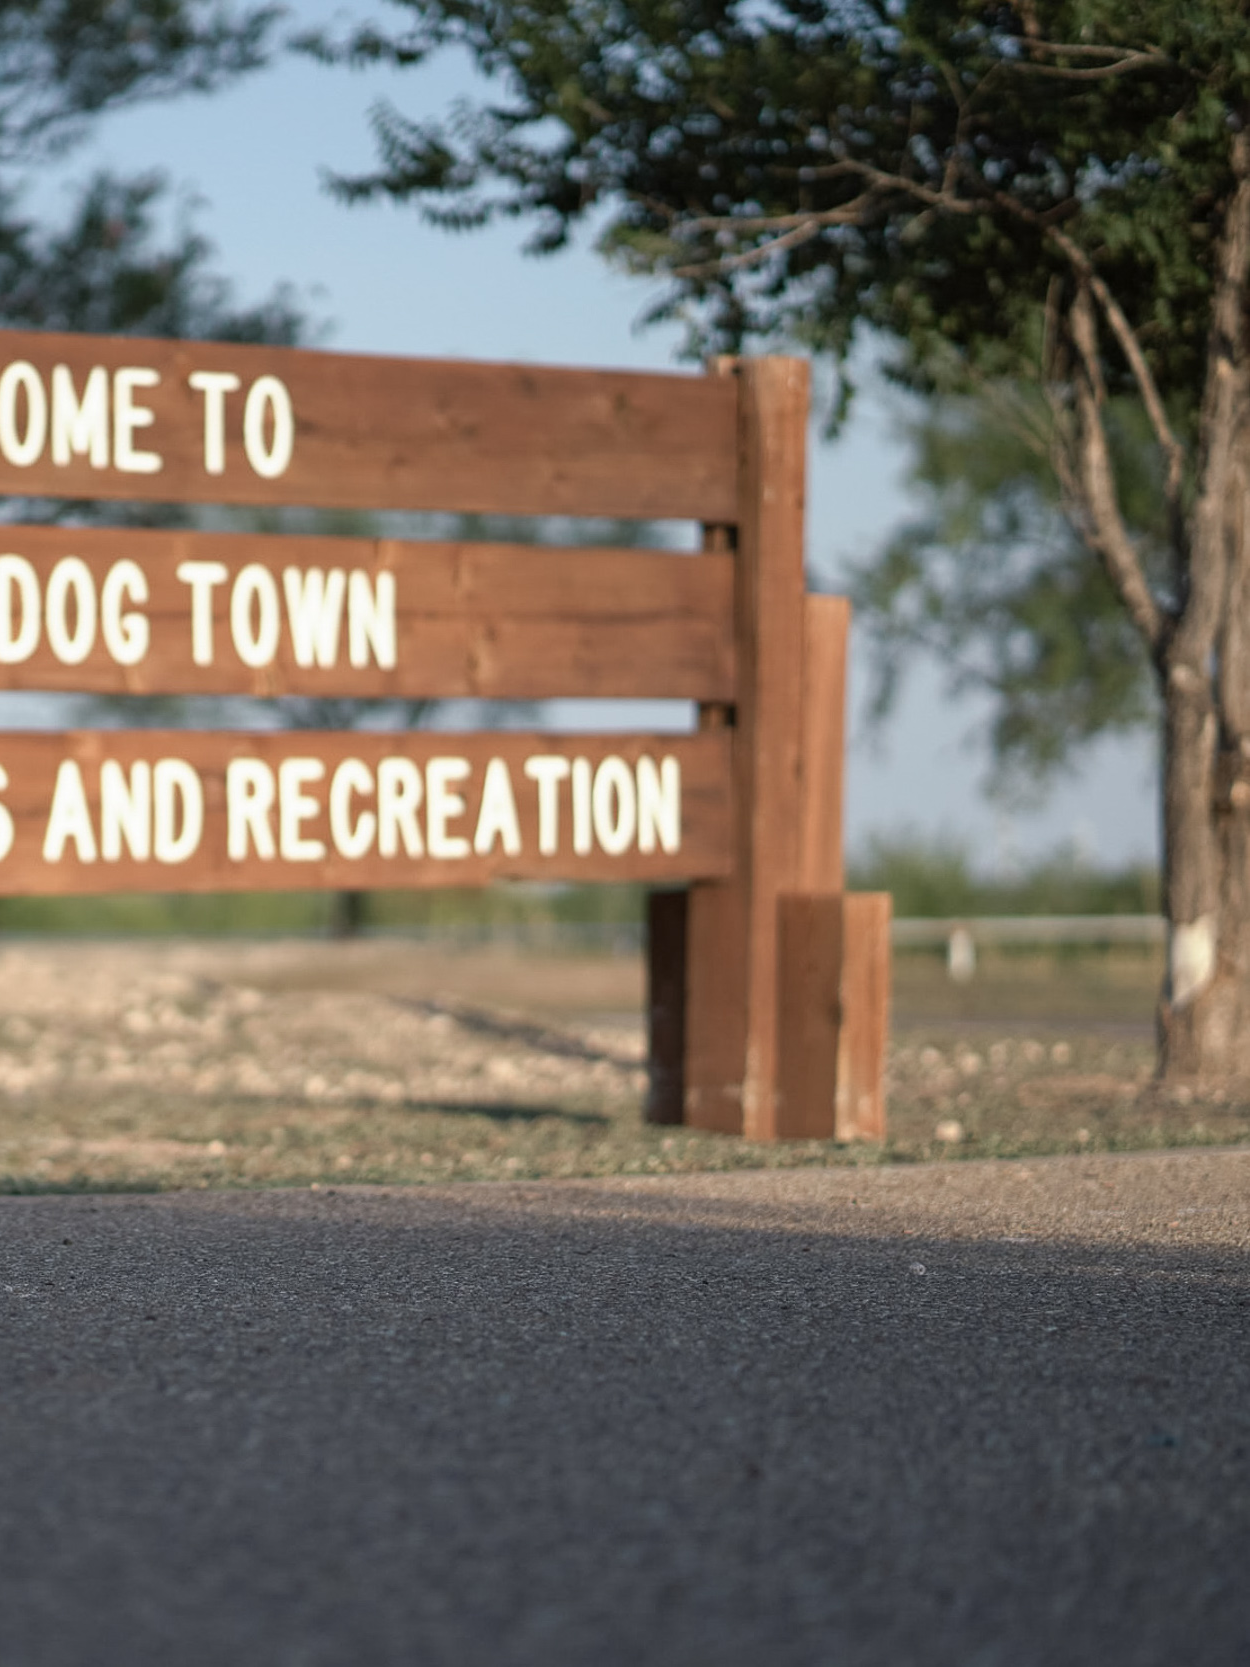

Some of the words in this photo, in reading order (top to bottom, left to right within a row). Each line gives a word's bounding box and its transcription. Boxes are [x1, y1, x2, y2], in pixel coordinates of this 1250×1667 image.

[189, 372, 294, 478] TO
[176, 562, 397, 669] TOWN
[42, 758, 203, 864] AND
[226, 755, 680, 862] RECREATION
